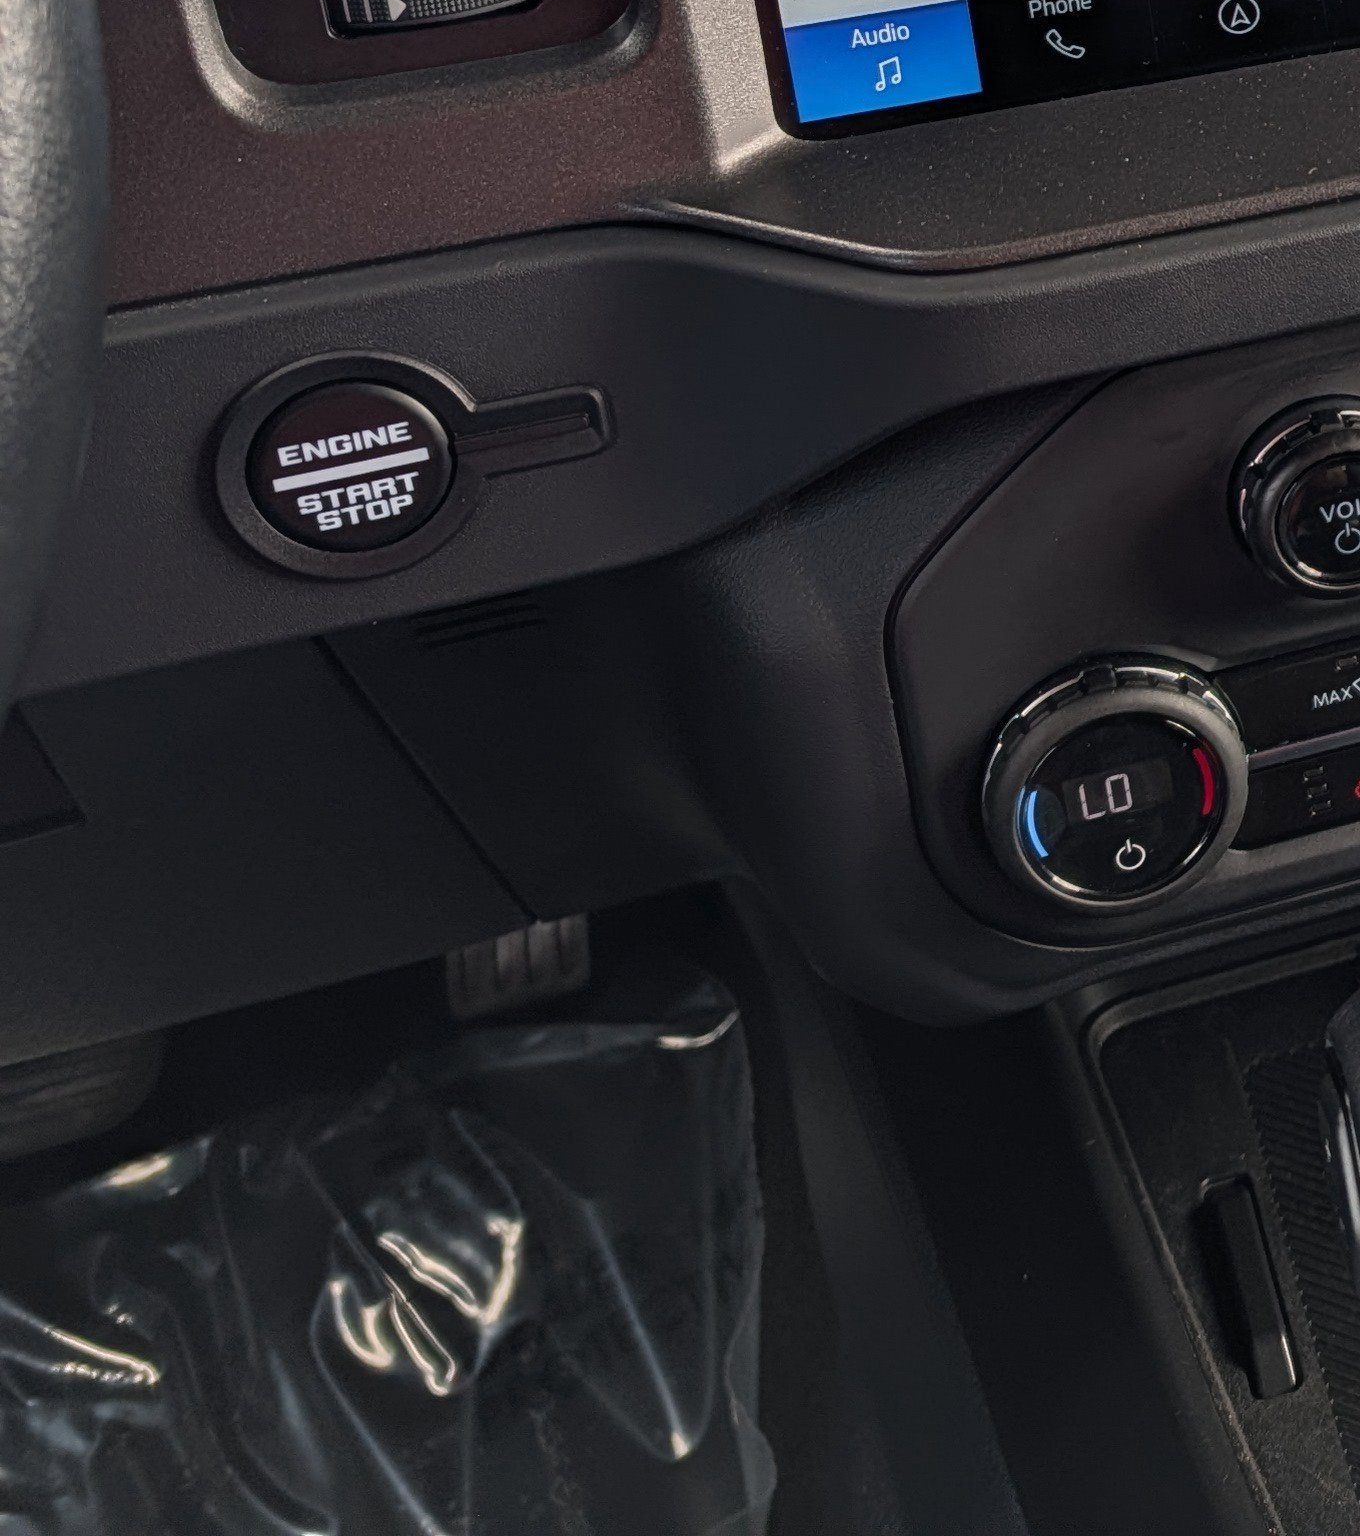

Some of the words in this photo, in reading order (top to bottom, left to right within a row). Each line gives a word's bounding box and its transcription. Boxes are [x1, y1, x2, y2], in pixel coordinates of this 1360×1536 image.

[850, 20, 911, 50] Audio
[276, 420, 413, 467] ENGINE
[296, 471, 420, 516] START
[316, 493, 415, 532] STOP
[1312, 686, 1353, 709] MAX
